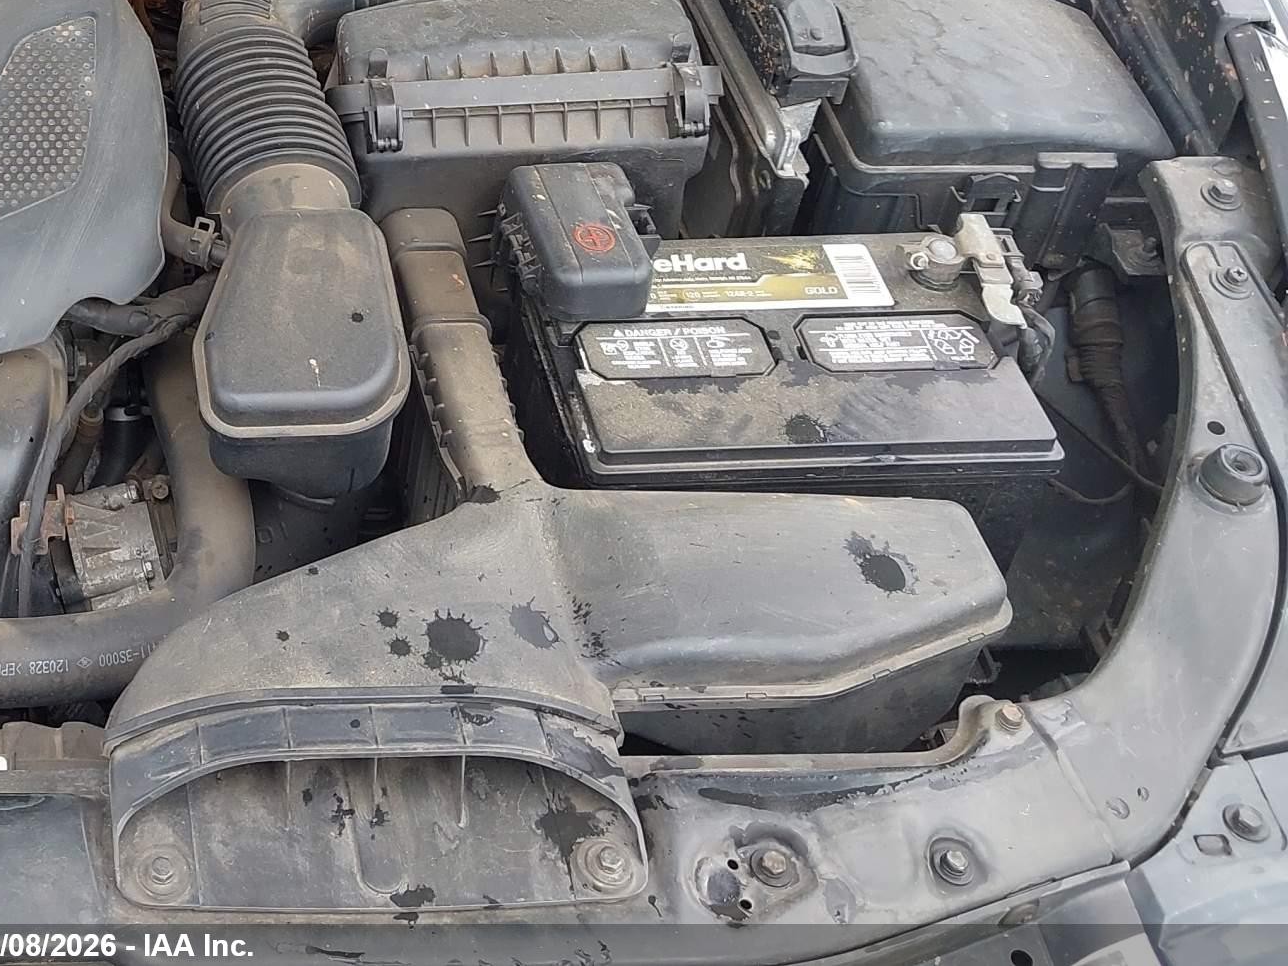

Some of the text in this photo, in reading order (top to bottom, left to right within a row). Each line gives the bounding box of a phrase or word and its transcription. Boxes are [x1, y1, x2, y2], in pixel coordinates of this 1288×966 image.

[650, 252, 748, 273] eHard
[804, 286, 839, 295] GOLD
[625, 328, 672, 337] DANGER
[682, 325, 726, 336] POISON
[29, 658, 69, 675] 120328
